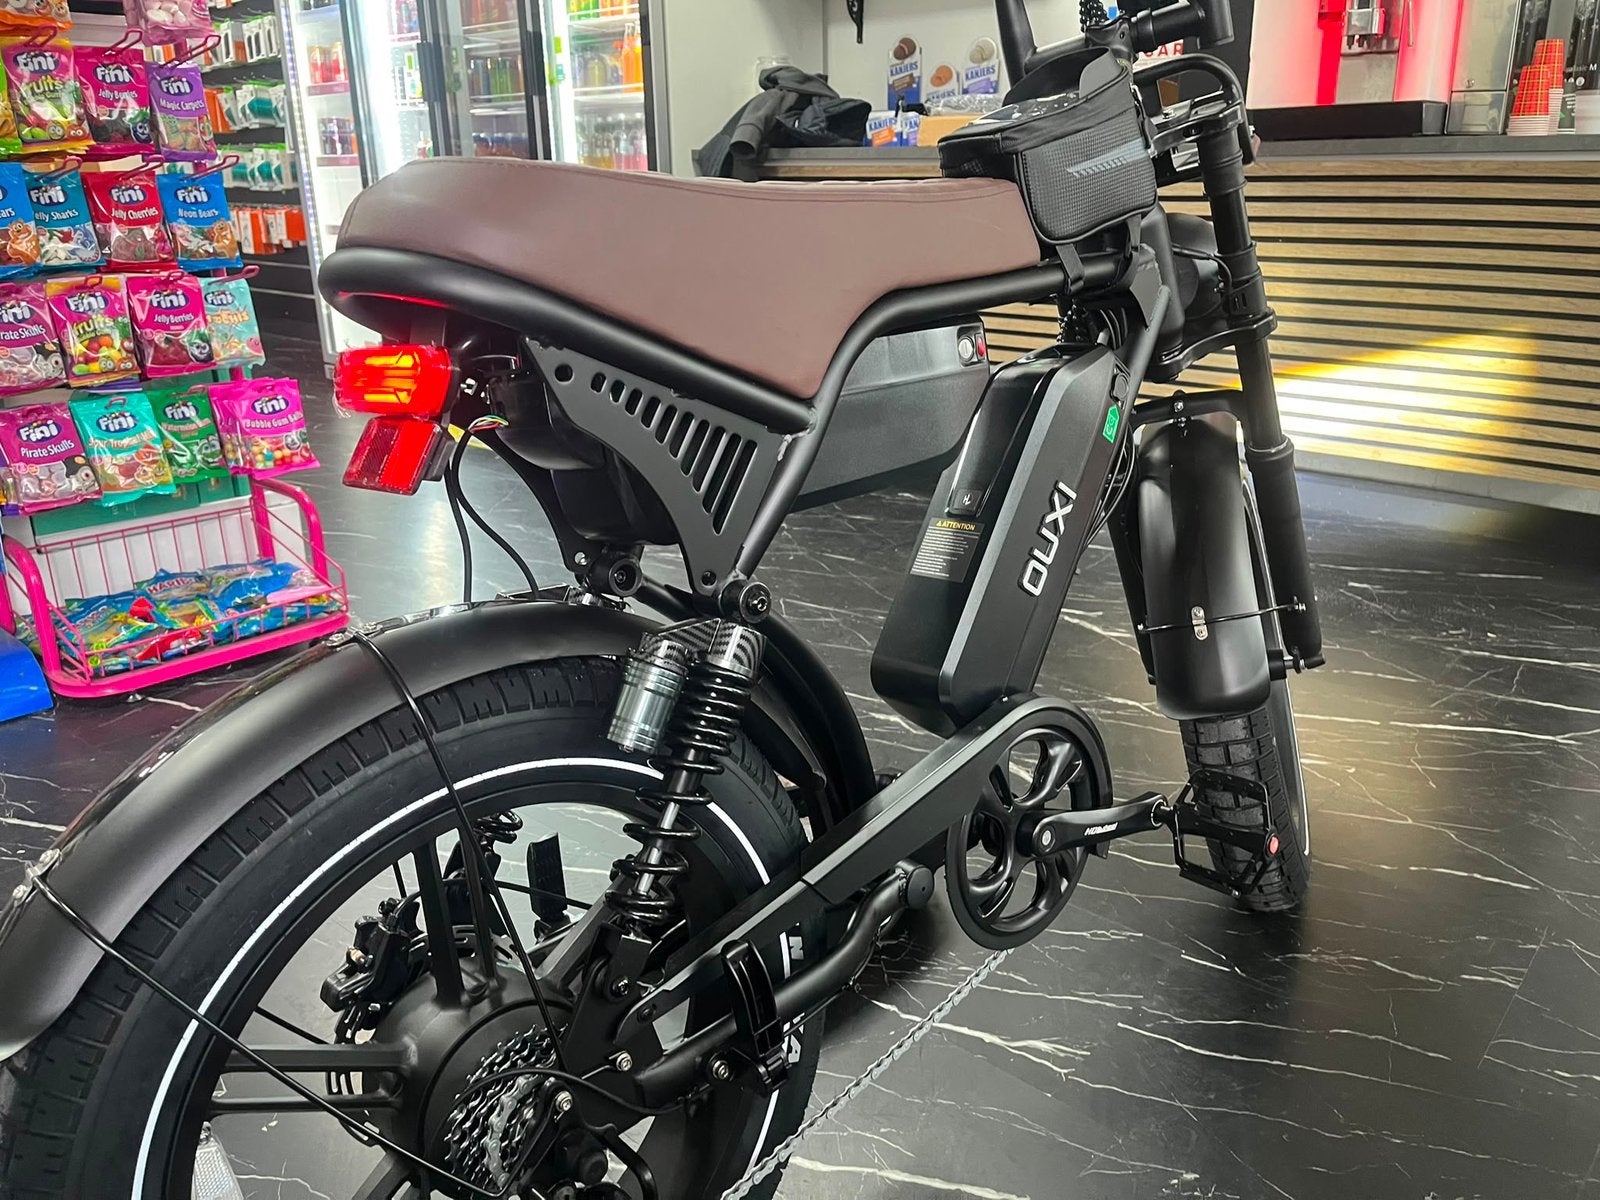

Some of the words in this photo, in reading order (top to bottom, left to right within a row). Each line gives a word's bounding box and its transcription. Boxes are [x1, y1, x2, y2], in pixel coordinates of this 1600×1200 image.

[17, 50, 56, 73] Fini
[890, 61, 919, 77] KANJERS
[96, 62, 131, 84] Fini
[965, 64, 996, 80] KANJERS
[23, 75, 64, 95] ruits
[161, 76, 192, 95] Fini
[98, 89, 114, 101] Jelly
[113, 89, 138, 100] Berries
[159, 97, 182, 111] Magic
[181, 99, 205, 111] Carpets
[30, 184, 66, 206] Fini
[111, 185, 144, 204] Fini
[177, 185, 209, 204] Fini
[34, 211, 50, 223] elly
[50, 208, 79, 221] Sharks
[111, 207, 127, 221] Jelly
[127, 206, 159, 221] Cherries
[178, 209, 200, 218] Neon
[199, 208, 219, 218] Bears
[69, 292, 106, 313] Fini
[151, 290, 187, 308] Fini
[206, 291, 235, 305] Fini
[0, 300, 32, 323] ini
[153, 313, 170, 325] Jelly
[169, 313, 194, 324] Berries
[18, 324, 46, 339] Skulls
[165, 402, 198, 420] Fini
[254, 395, 287, 414] Fini
[98, 412, 136, 433] Fini
[245, 419, 272, 429] Bubble
[271, 417, 290, 428] Gum
[19, 421, 60, 443] Fini
[20, 444, 49, 459] Pirate
[49, 440, 75, 456] Skulls
[942, 520, 976, 531] ATTENTION
[1022, 480, 1077, 597] OUXI
